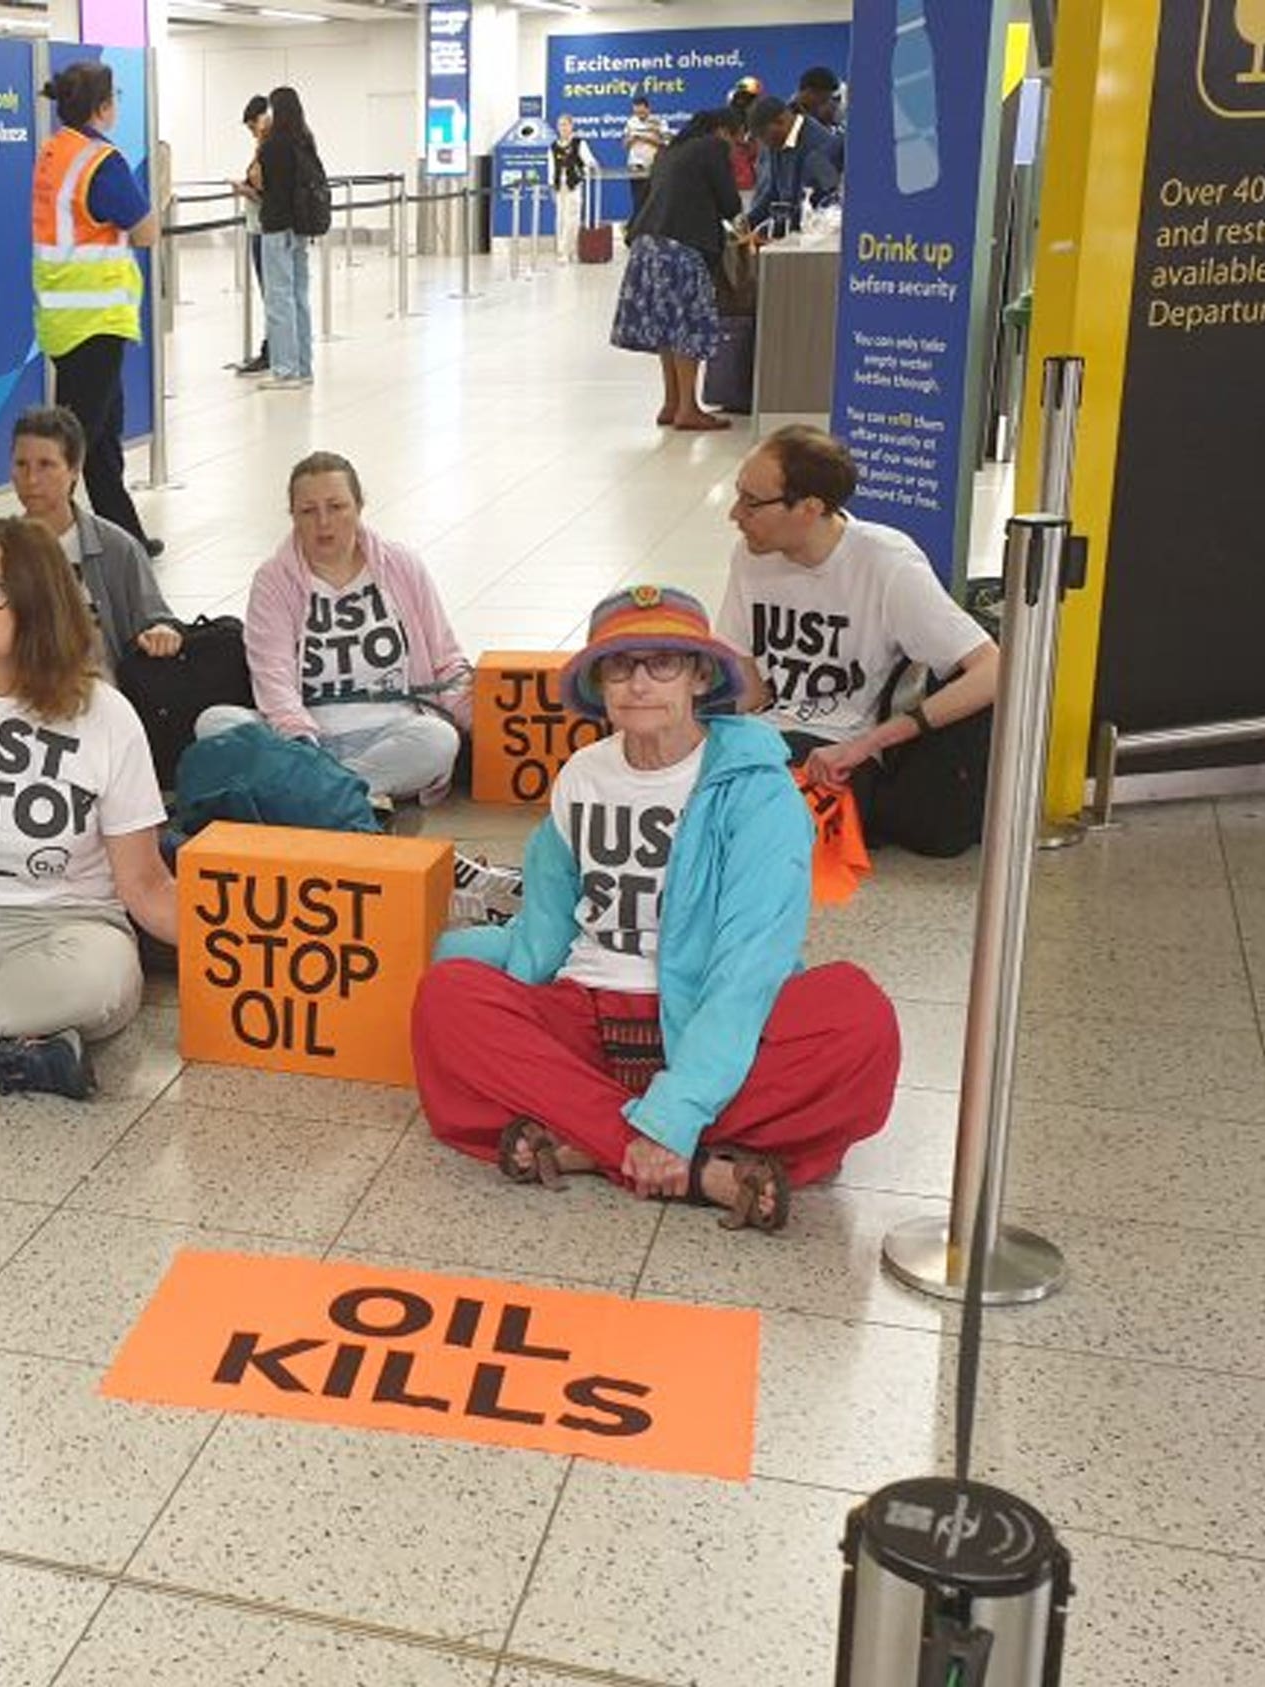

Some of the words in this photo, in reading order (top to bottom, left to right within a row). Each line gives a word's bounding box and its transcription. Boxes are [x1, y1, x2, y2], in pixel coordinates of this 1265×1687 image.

[564, 52, 673, 74] Excitement
[677, 50, 745, 69] ahead,
[564, 78, 638, 98] security
[643, 76, 685, 93] first
[1160, 177, 1227, 207] Over
[858, 232, 918, 263] Drink
[924, 242, 953, 270] up
[1156, 218, 1208, 248] and
[849, 274, 895, 295] before
[897, 276, 958, 302] security
[306, 583, 388, 633] UST
[752, 603, 850, 657] JUST
[302, 621, 409, 678] STO
[503, 715, 604, 757] STO
[195, 868, 383, 941] JUST
[204, 929, 379, 998] STOP
[230, 990, 337, 1057] OIL
[328, 1286, 570, 1361] OIL
[212, 1331, 654, 1437] KILLS
